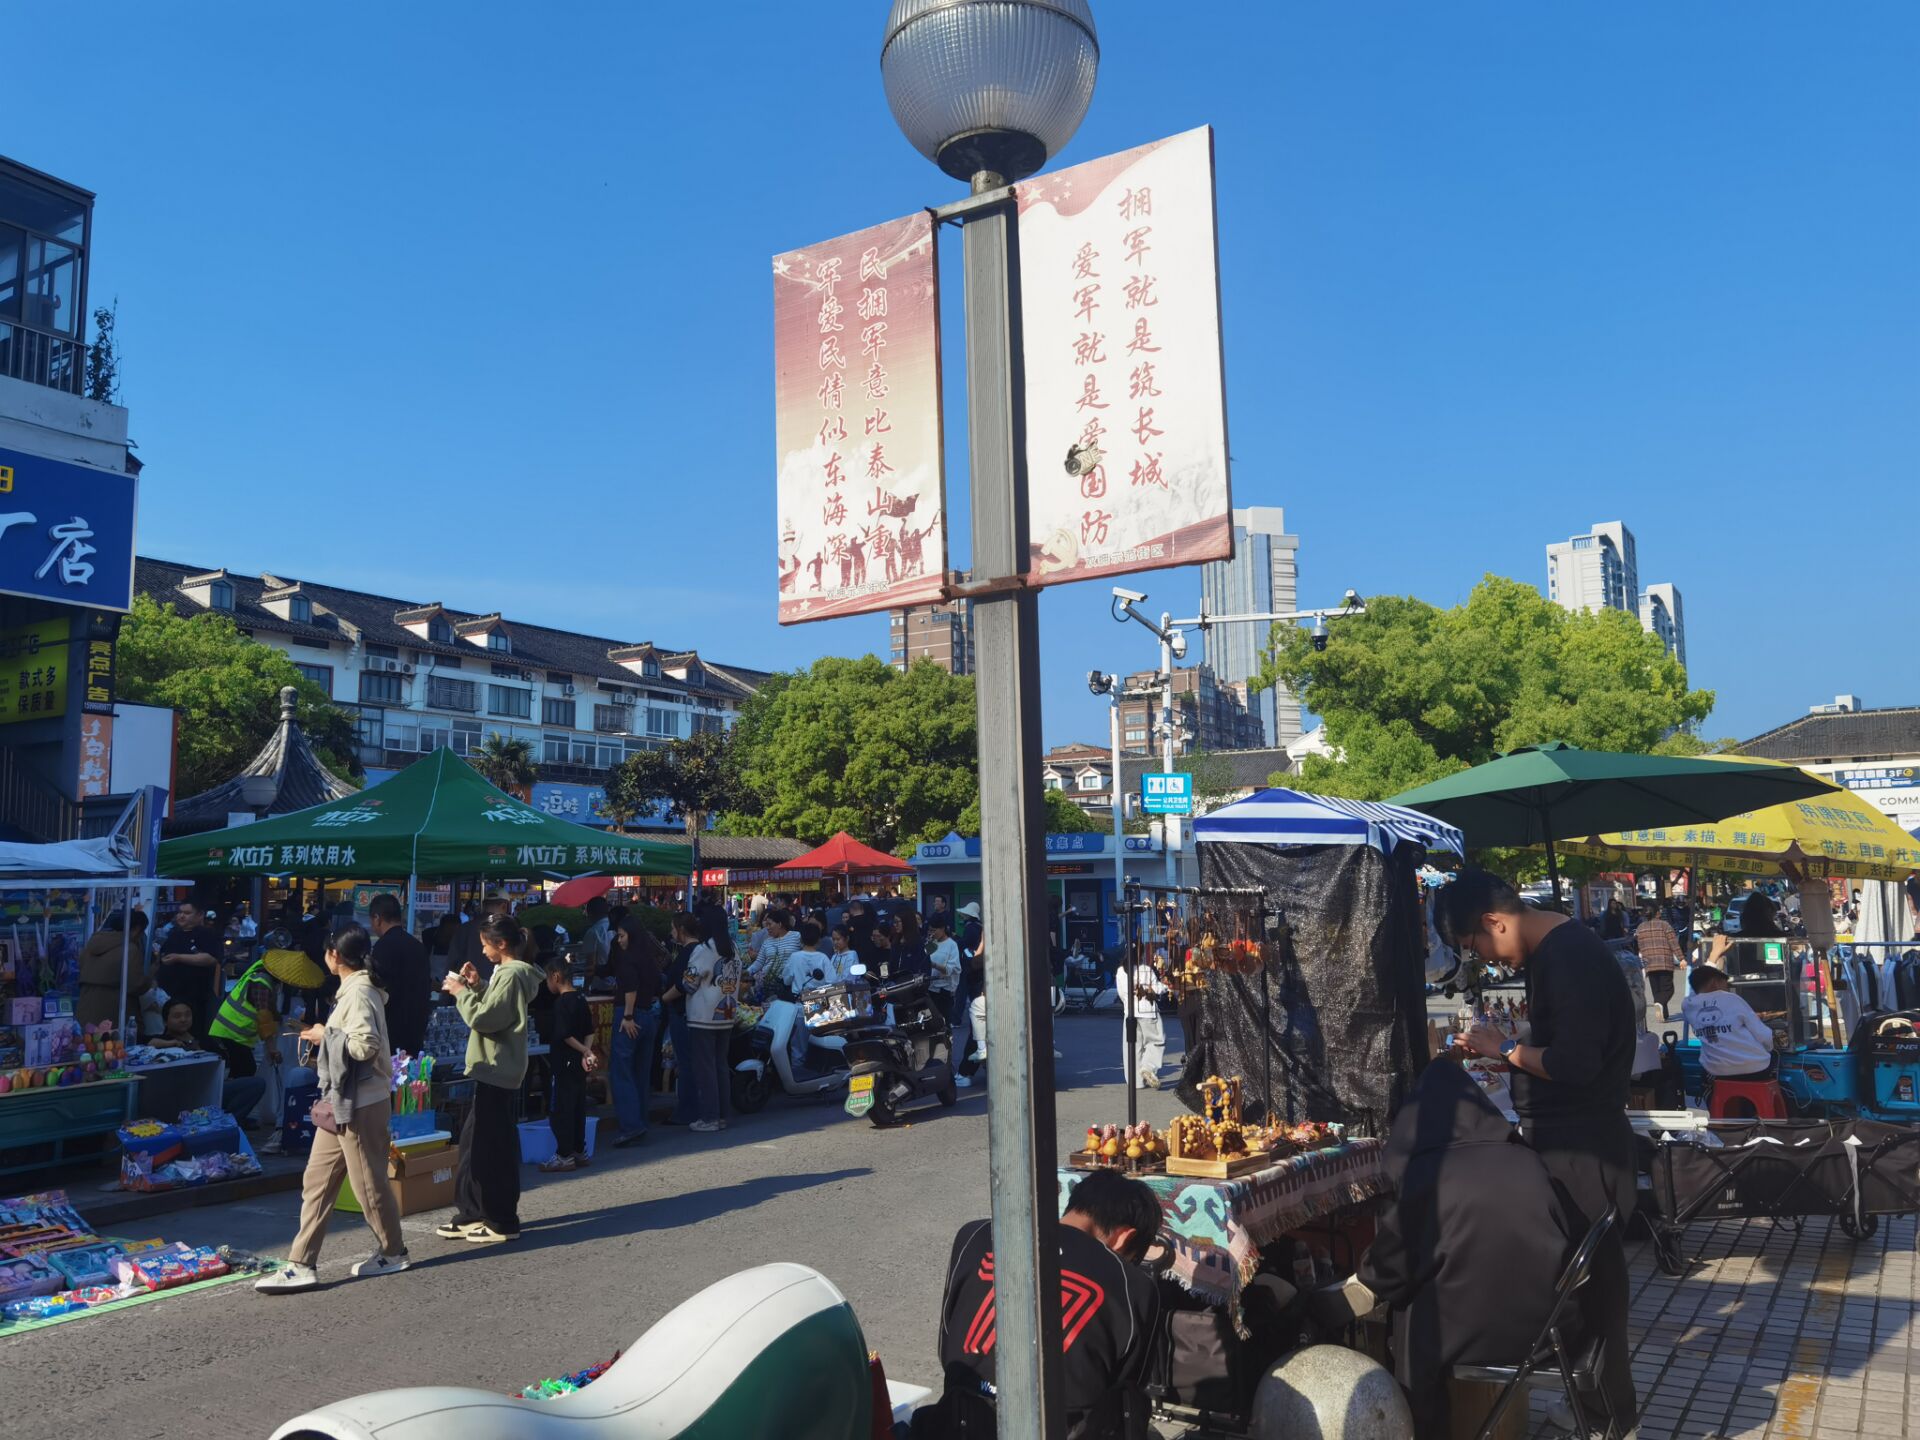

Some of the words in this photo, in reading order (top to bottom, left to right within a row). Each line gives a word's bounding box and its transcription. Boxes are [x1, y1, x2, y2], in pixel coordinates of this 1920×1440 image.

[816, 257, 850, 565] 军爱民情似东海深
[857, 247, 894, 560] 民拥军意比泰山重
[1118, 187, 1168, 489] 拥军就是筑长城
[229, 846, 274, 868] 水立方
[280, 845, 356, 866] 系列饮用水
[517, 845, 569, 867] 水立方
[575, 846, 645, 866] 系列饮用水
